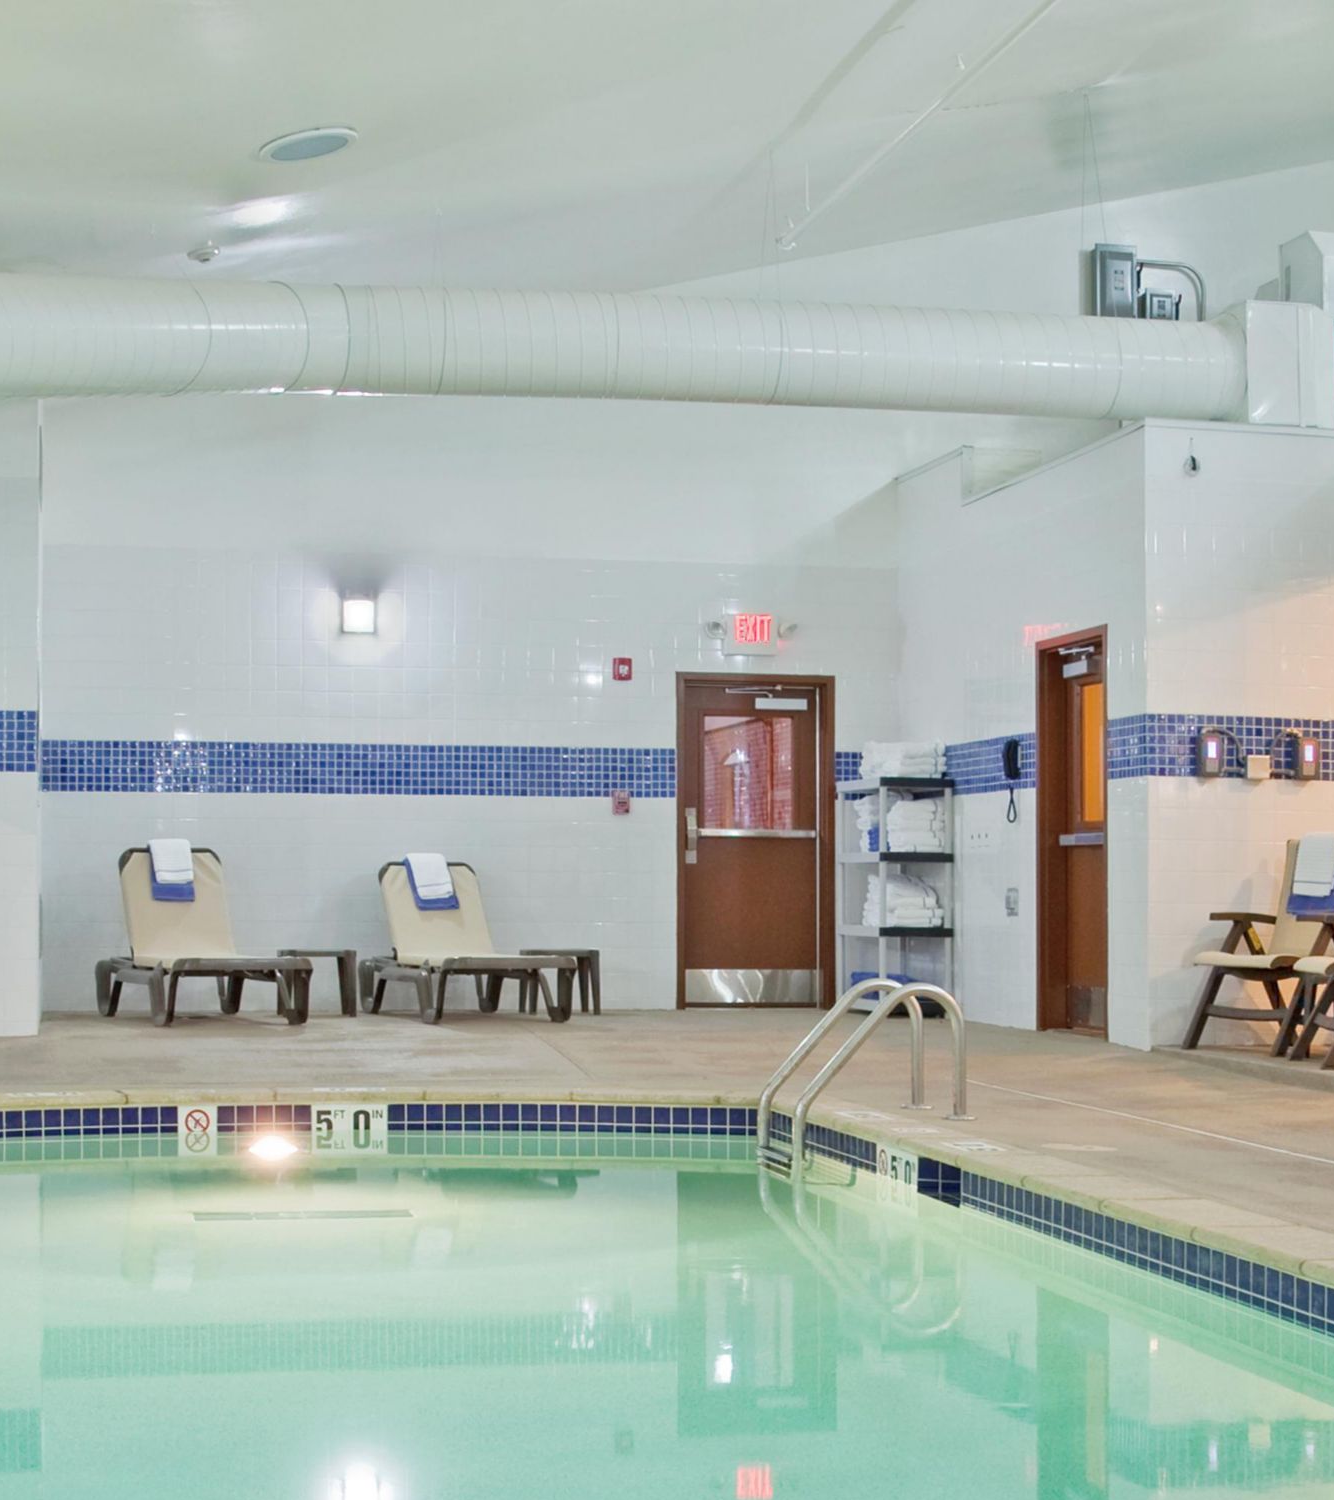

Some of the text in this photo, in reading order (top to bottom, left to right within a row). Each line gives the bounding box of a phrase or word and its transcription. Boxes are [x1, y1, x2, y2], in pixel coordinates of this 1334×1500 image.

[735, 614, 772, 643] EXIT
[334, 1110, 345, 1119] FT
[372, 1110, 383, 1119] IN
